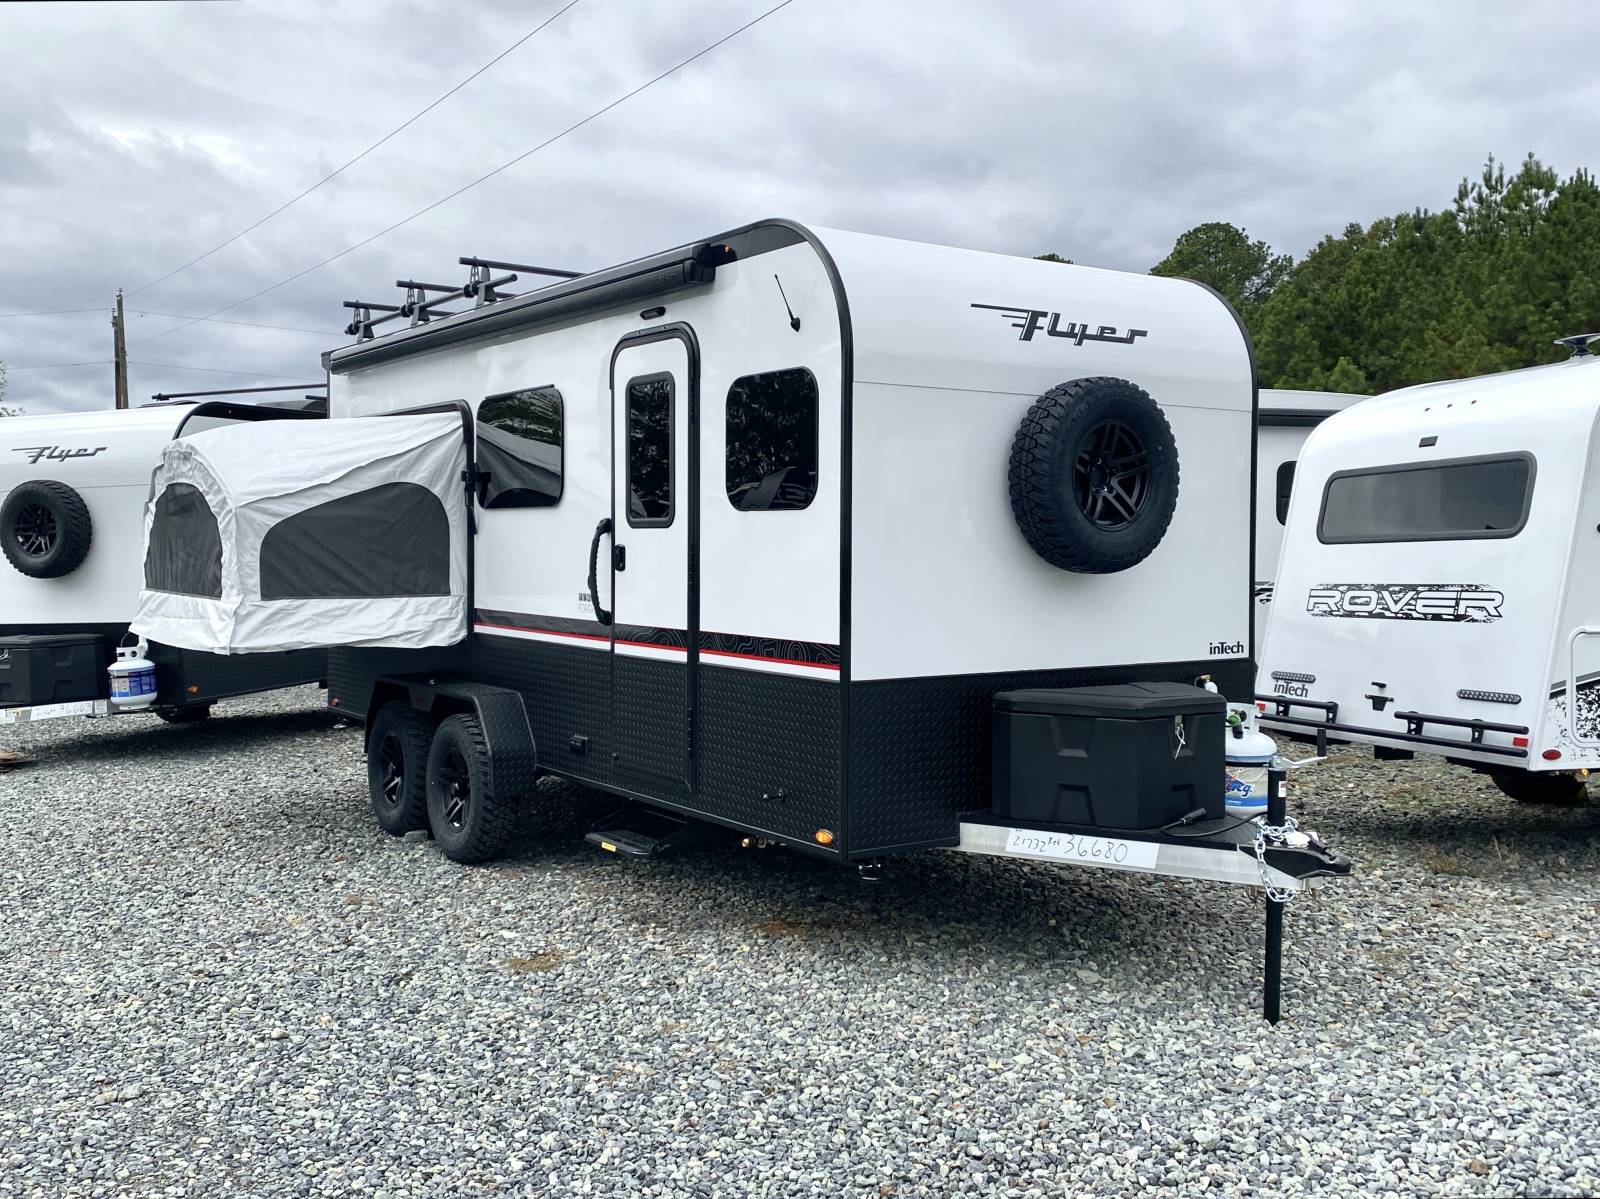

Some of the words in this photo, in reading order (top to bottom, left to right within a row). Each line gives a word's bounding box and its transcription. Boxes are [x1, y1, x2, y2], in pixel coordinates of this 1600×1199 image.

[971, 303, 1148, 346] Flyer
[11, 445, 108, 465] Flyer
[1306, 588, 1505, 618] ROVER
[1209, 640, 1245, 656] inTech
[1273, 679, 1309, 698] inTech
[1063, 833, 1129, 863] 36680
